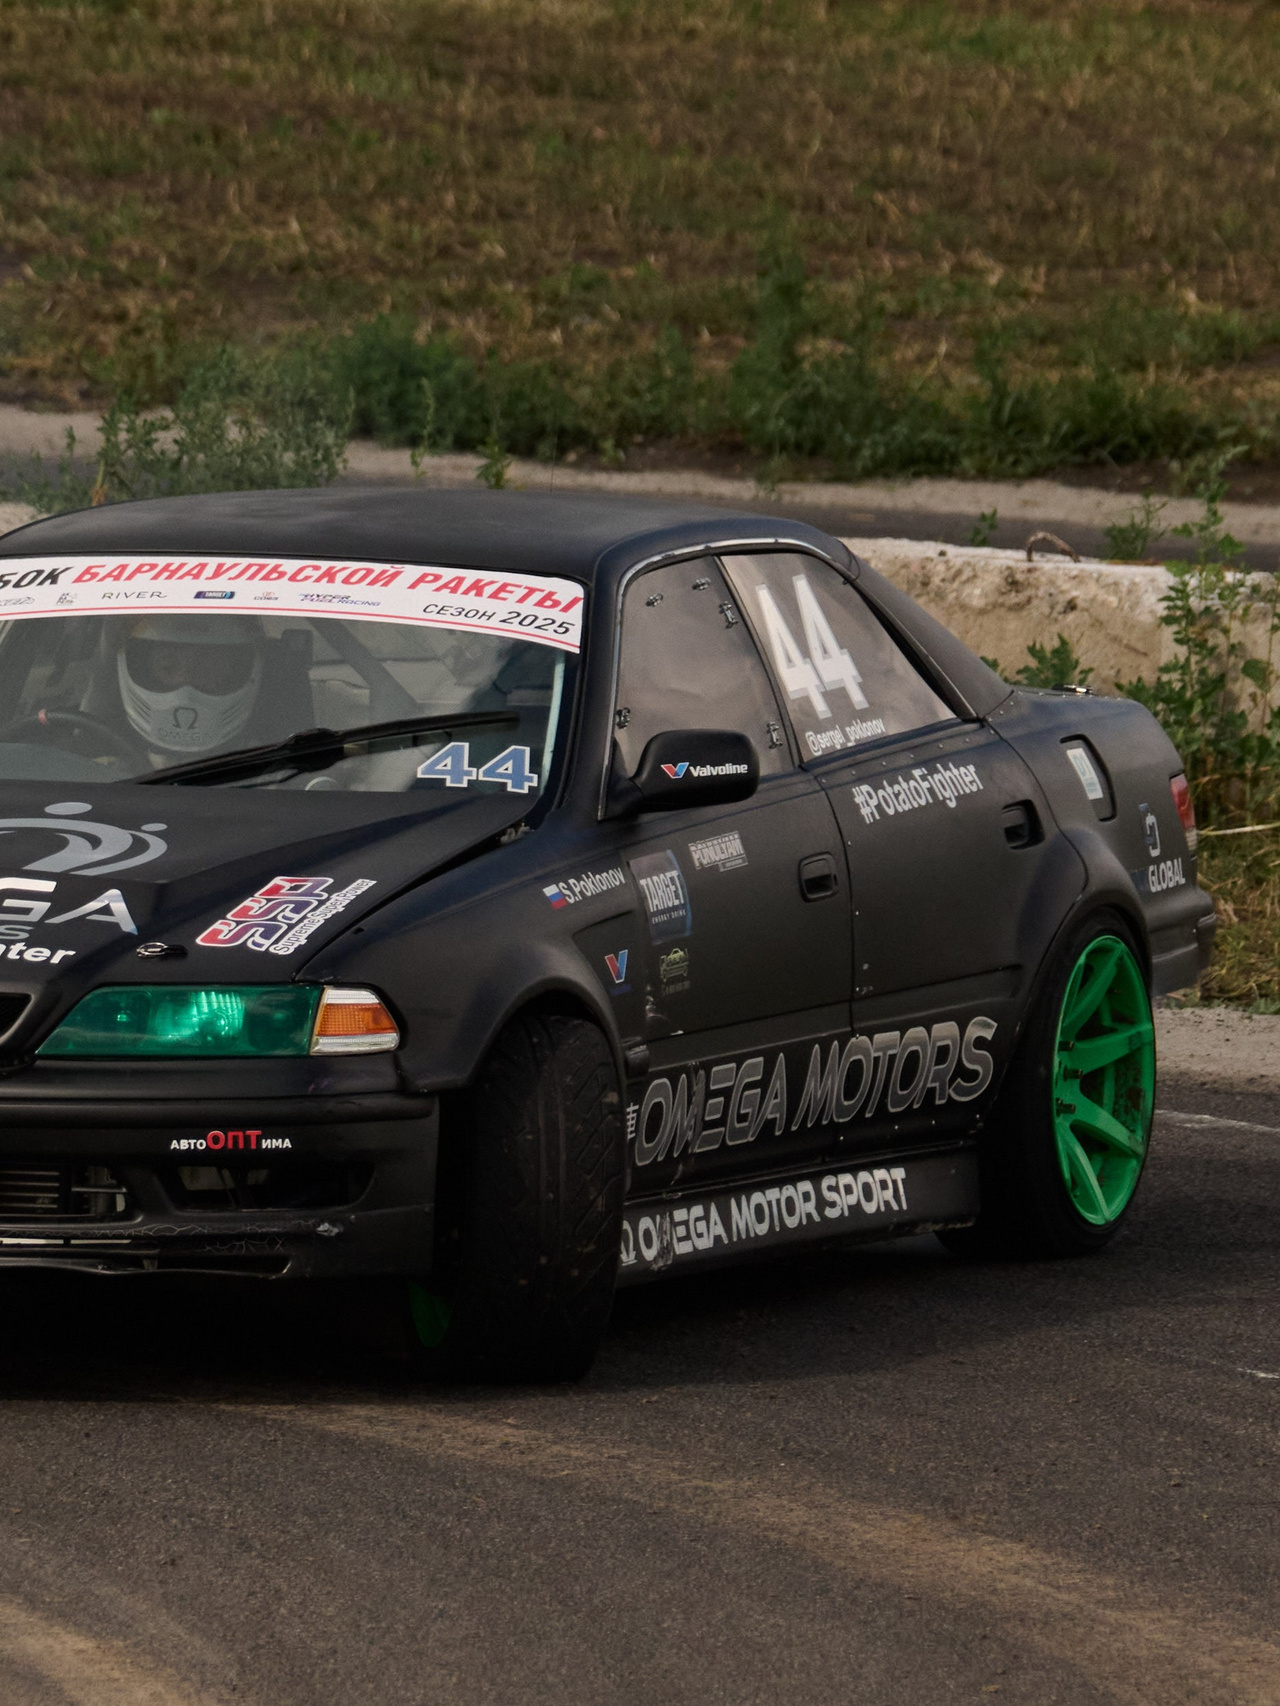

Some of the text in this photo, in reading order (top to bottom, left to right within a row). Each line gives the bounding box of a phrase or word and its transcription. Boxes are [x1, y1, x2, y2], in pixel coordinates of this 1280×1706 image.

[71, 562, 405, 589] БАРНАУЛЬСКОЙ
[407, 572, 584, 613] РАКЕТЫ
[102, 591, 167, 600] RIVER
[422, 603, 575, 635] СЕЗОН 2025
[755, 574, 869, 719] 44
[417, 742, 538, 793] 44
[689, 763, 748, 777] Valvoline
[852, 761, 984, 824] #PotatoFighter
[558, 867, 626, 904] S.Poklonov
[639, 869, 685, 912] TARGET
[1148, 858, 1186, 893] GLOBAL
[274, 879, 373, 954] Supreme Super Power
[635, 1016, 998, 1166] OMEGA MOTORS
[731, 1180, 820, 1242] MOTOR
[821, 1167, 908, 1219] SPORT
